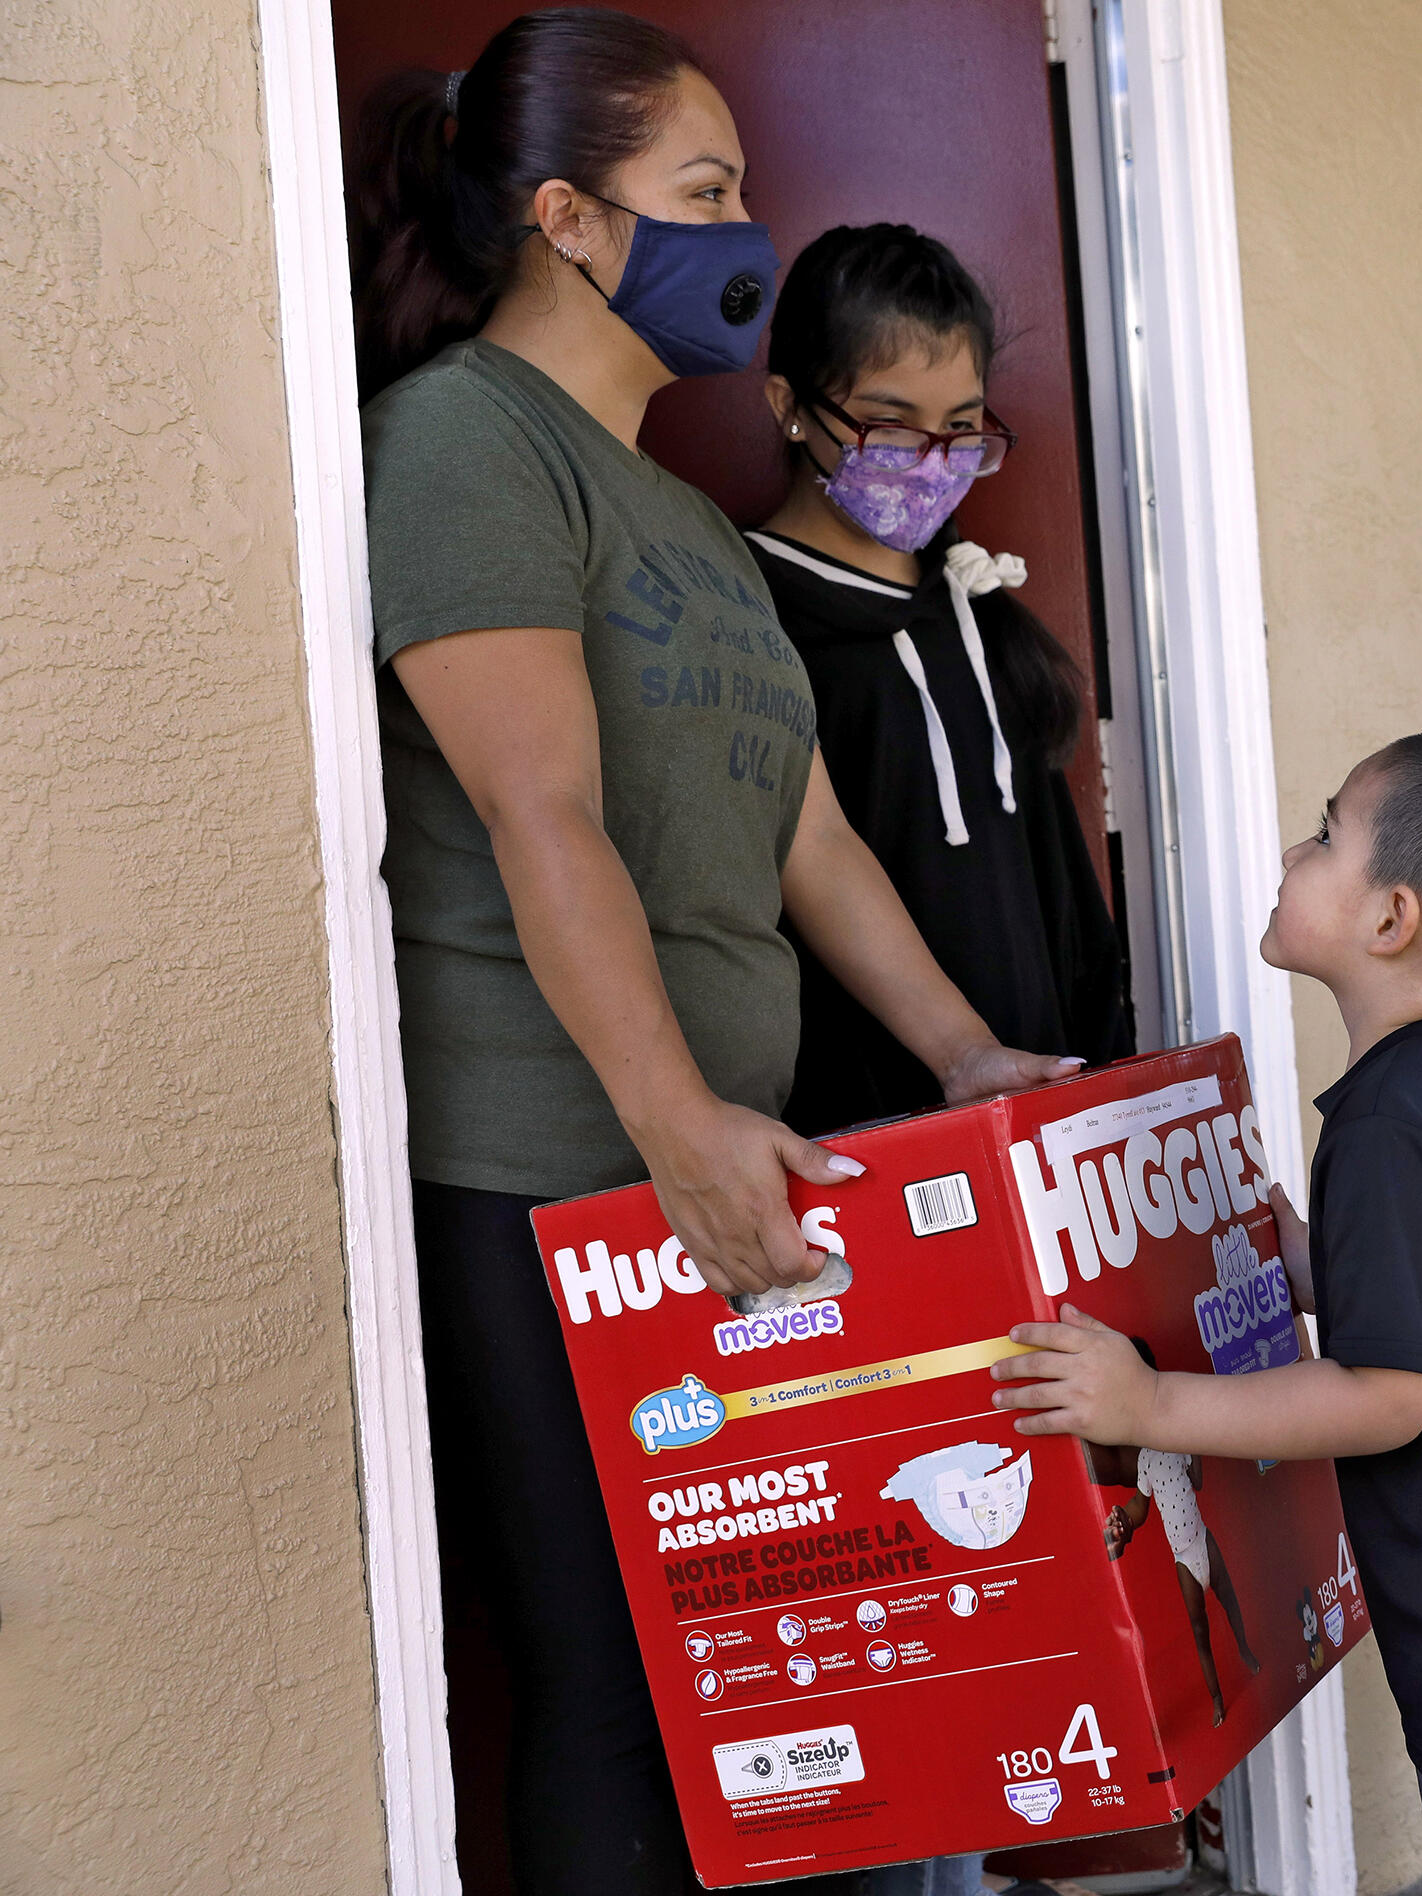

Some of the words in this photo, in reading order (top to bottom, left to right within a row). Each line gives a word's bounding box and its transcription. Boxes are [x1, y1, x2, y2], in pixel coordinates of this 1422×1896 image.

[640, 666, 721, 708] SAN
[1009, 1105, 1271, 1297] HUGGIES
[554, 1206, 846, 1325] HUGS
[1216, 1232, 1256, 1286] little
[1199, 1265, 1289, 1343] movers
[718, 1305, 839, 1350] movers
[778, 1382, 827, 1401] Comfort
[835, 1370, 882, 1389] Confort
[639, 1397, 719, 1451] plus
[648, 1482, 726, 1522] OUR
[728, 1460, 829, 1507] MOST
[664, 1550, 757, 1587] NOTRE
[760, 1528, 873, 1568] COUCHE
[875, 1520, 915, 1548] LA
[1318, 1576, 1338, 1610] 180
[1338, 1532, 1357, 1596] 4
[981, 1578, 1018, 1590] Contoured
[670, 1581, 740, 1615] PLUS
[923, 1592, 941, 1600] Liner
[983, 1589, 1005, 1598] Shape
[918, 1603, 928, 1611] dry
[808, 1616, 831, 1625] Double
[715, 1632, 727, 1640] Our
[727, 1630, 743, 1638] Most
[810, 1624, 825, 1633] Grip
[717, 1636, 743, 1647] Tailored
[898, 1640, 924, 1651] Huggies
[900, 1648, 929, 1657] Wetness
[723, 1663, 770, 1676] Hypoallergenic
[821, 1659, 856, 1670] Waistband
[731, 1672, 763, 1683] Fragrance
[763, 1669, 778, 1677] Free
[996, 1747, 1053, 1779] 180
[1059, 1704, 1118, 1780] 4
[795, 1760, 840, 1774] INDICATOR
[797, 1769, 842, 1781] INDICATEUR
[1020, 1792, 1049, 1802] diapers
[1088, 1786, 1112, 1796] 22-37
[1112, 1784, 1121, 1793] lb
[730, 1802, 749, 1810] When
[760, 1797, 774, 1806] tabs
[774, 1795, 788, 1804] land
[788, 1793, 802, 1802] past
[743, 1809, 758, 1817] time
[758, 1807, 765, 1815] to
[764, 1805, 782, 1814] move
[790, 1802, 801, 1810] the
[801, 1800, 816, 1808] next
[1091, 1797, 1113, 1807] 10-17
[1114, 1796, 1125, 1806] kg
